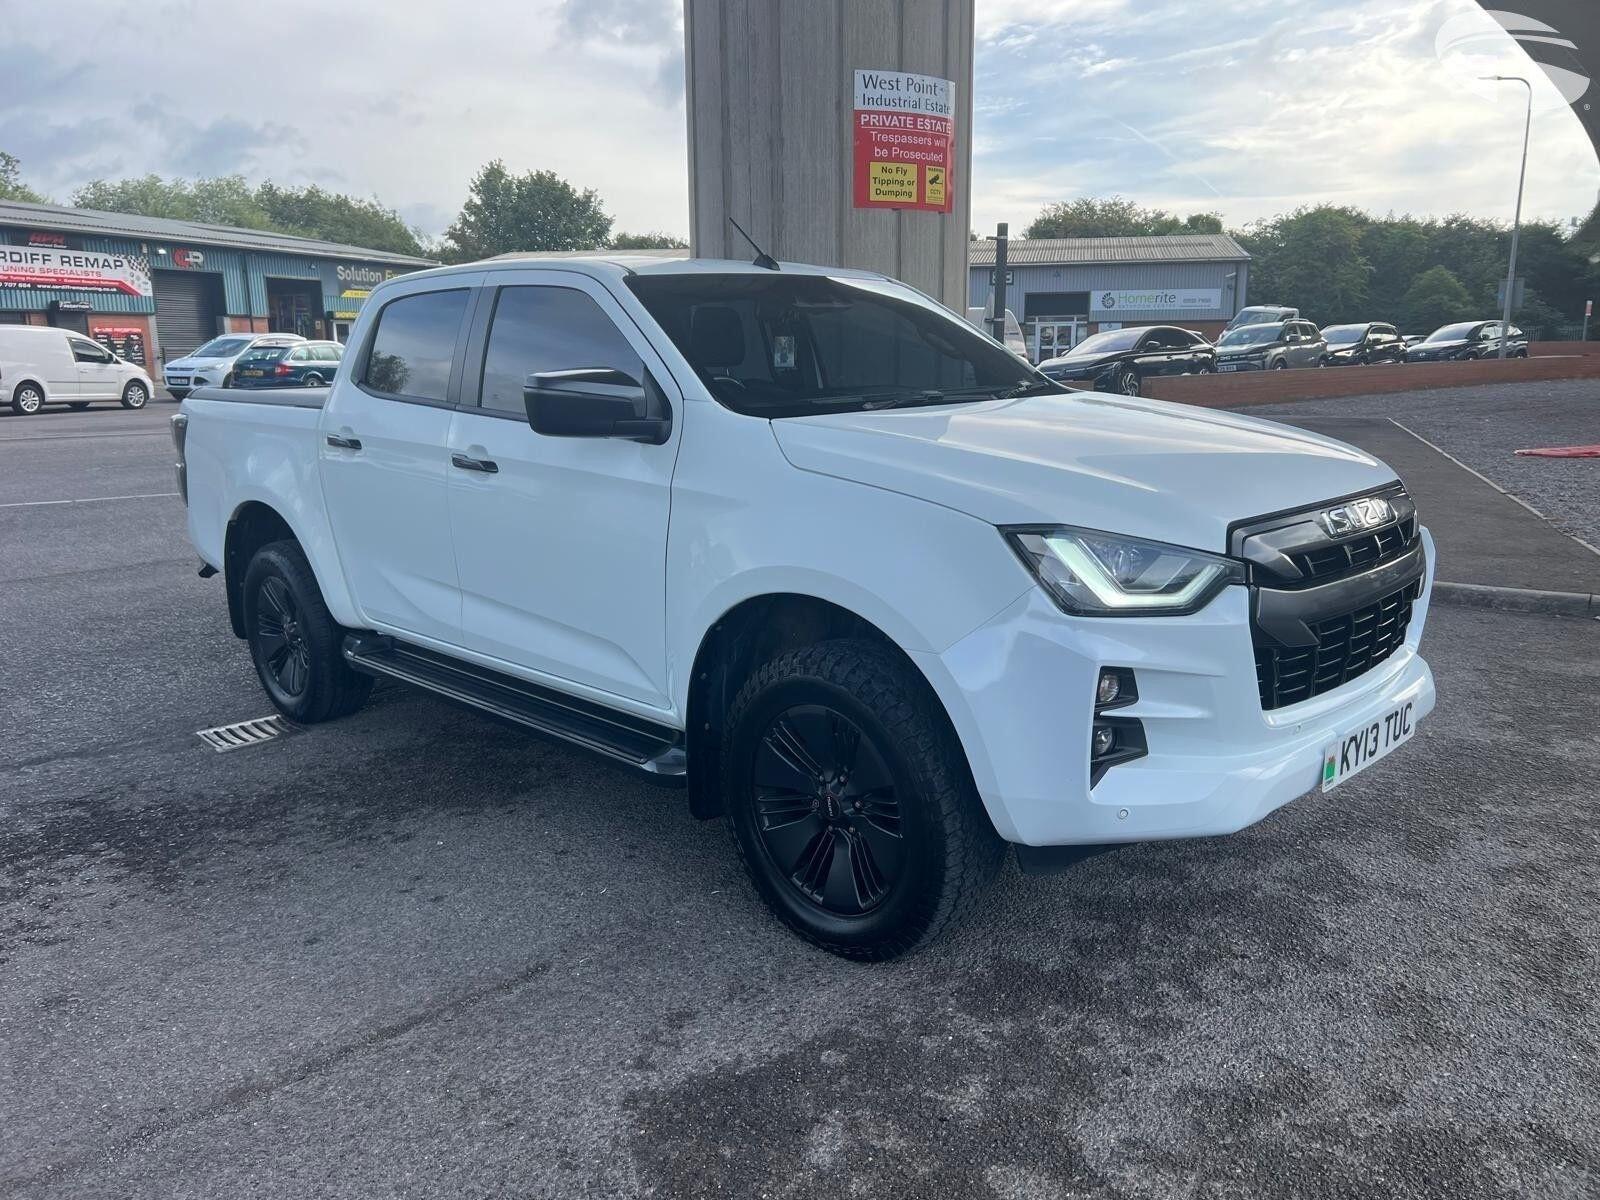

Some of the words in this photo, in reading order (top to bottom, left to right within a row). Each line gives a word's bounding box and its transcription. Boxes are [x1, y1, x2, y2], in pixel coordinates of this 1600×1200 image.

[862, 73, 901, 92] West
[906, 77, 939, 97] Point
[862, 93, 921, 110] Industrial
[925, 98, 951, 115] Estate
[860, 114, 914, 128] PRIVATE
[917, 117, 952, 134] ESTATE
[870, 131, 932, 146] Trespassers
[933, 137, 946, 148] will
[874, 146, 889, 157] be
[892, 147, 943, 163] Prosecuted
[881, 166, 893, 174] No
[895, 167, 908, 176] Fly
[872, 176, 905, 187] Tipping
[875, 188, 913, 198] Dumping
[60, 254, 124, 270] REMAP
[39, 267, 102, 278] SPECIALISTS
[336, 264, 383, 283] Solution
[1118, 291, 1177, 304] Homerite
[1320, 497, 1391, 535] ISUZU
[1339, 722, 1380, 776] KY13
[1384, 702, 1413, 748] TUC
